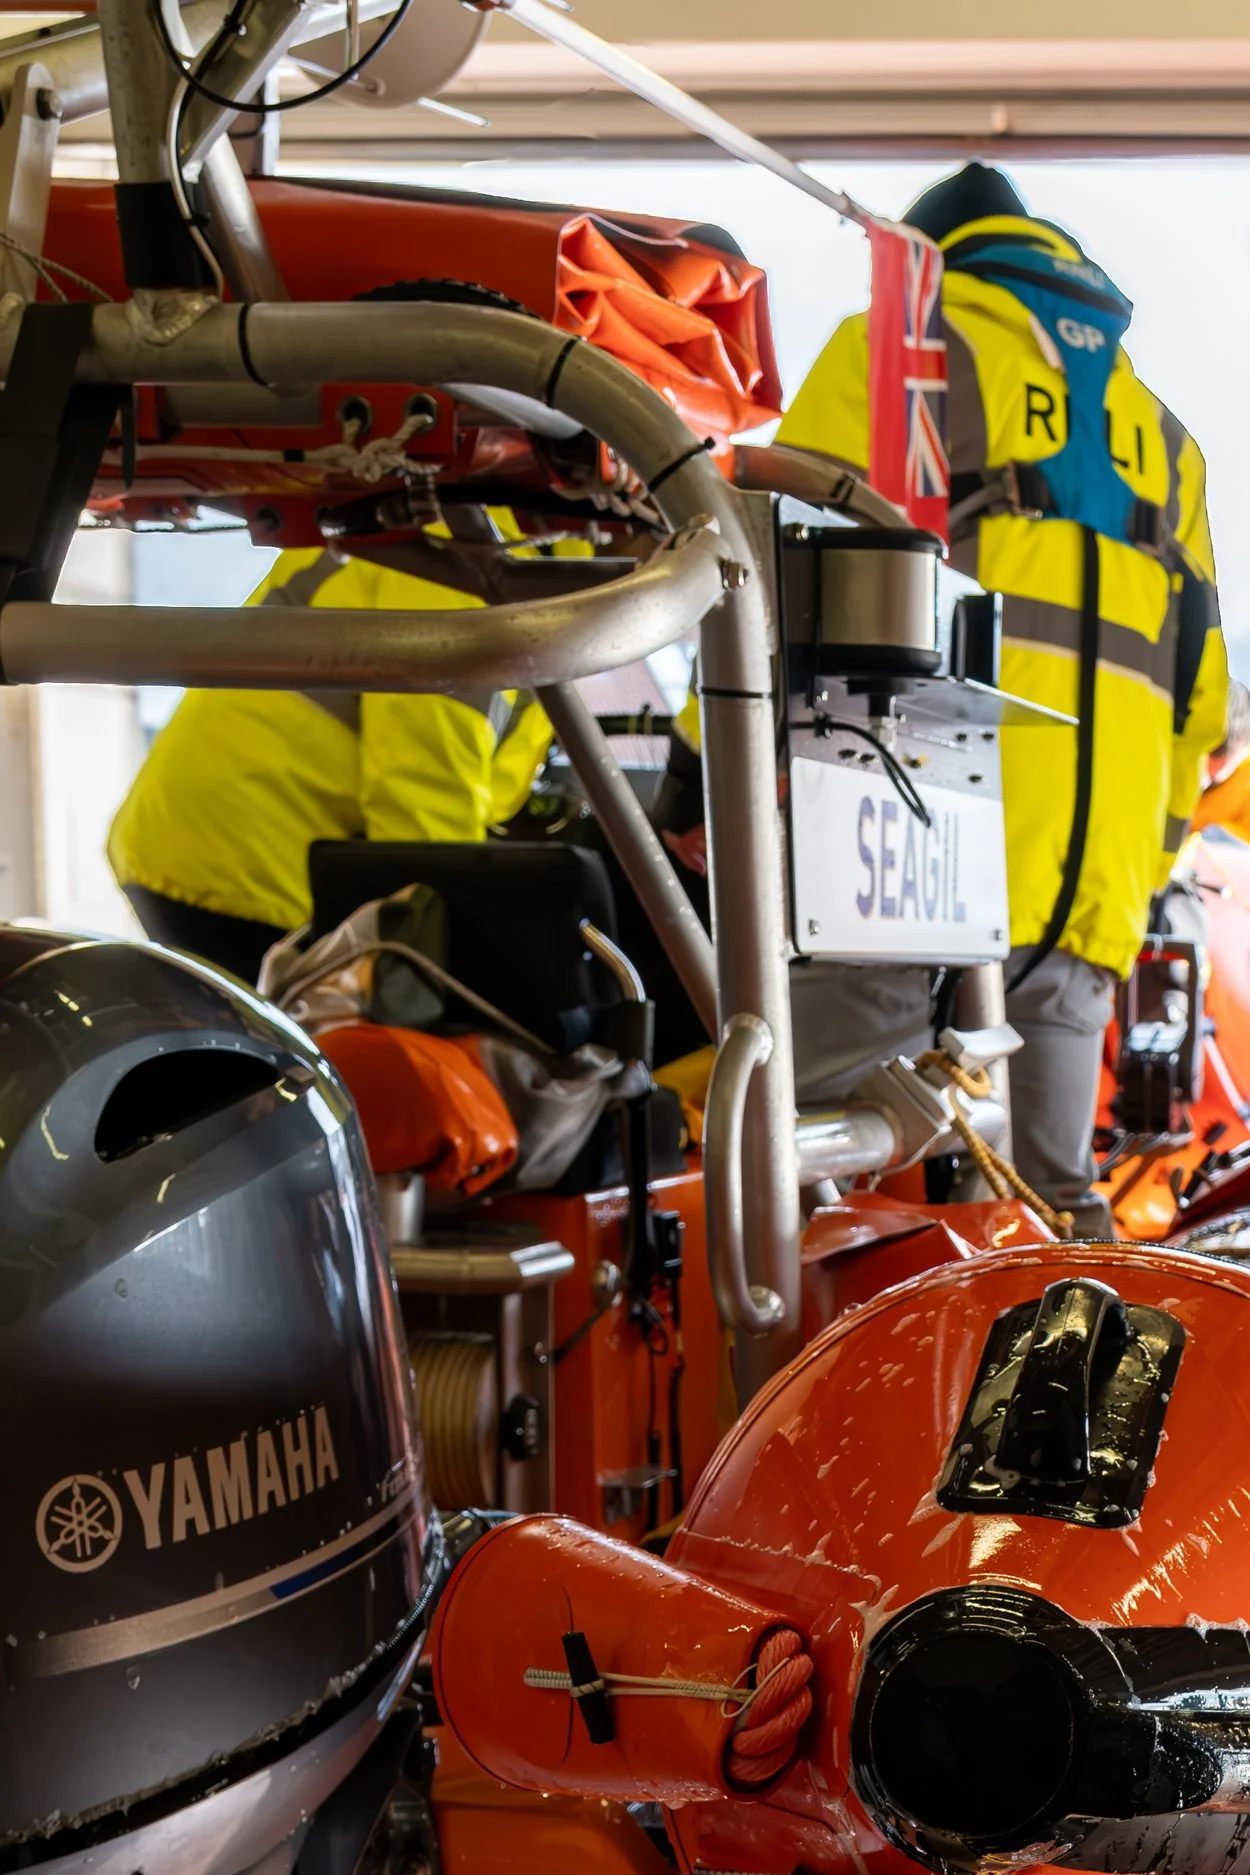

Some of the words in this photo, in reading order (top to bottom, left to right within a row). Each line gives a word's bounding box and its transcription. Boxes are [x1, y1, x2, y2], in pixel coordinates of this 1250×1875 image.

[1056, 317, 1106, 353] GP
[1025, 383, 1144, 475] RLI
[123, 1405, 339, 1550] YAMAHA
